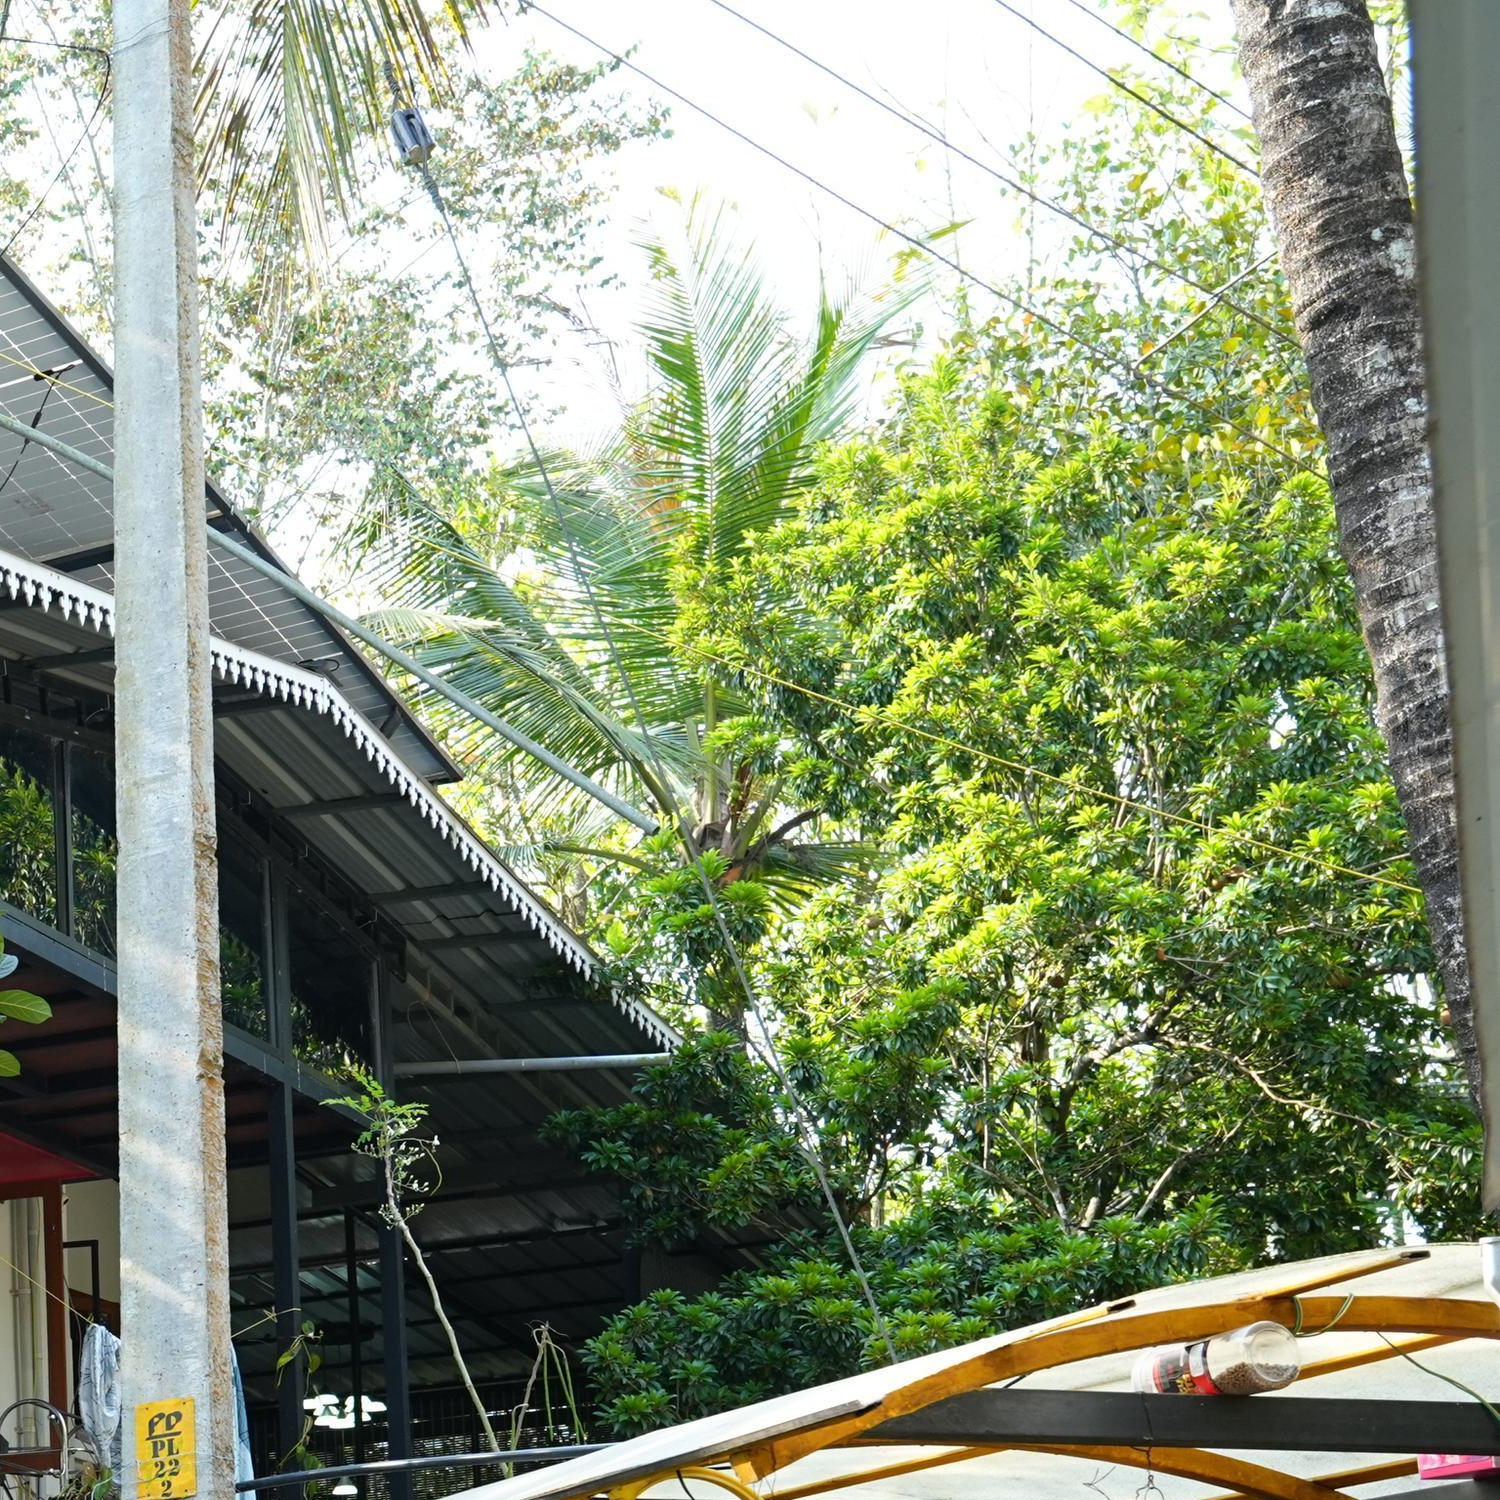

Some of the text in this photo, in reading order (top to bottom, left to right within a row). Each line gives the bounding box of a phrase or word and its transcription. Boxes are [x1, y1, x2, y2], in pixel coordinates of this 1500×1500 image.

[151, 1439, 180, 1459] PL
[154, 1459, 180, 1478] 22
[161, 1480, 173, 1497] 2
